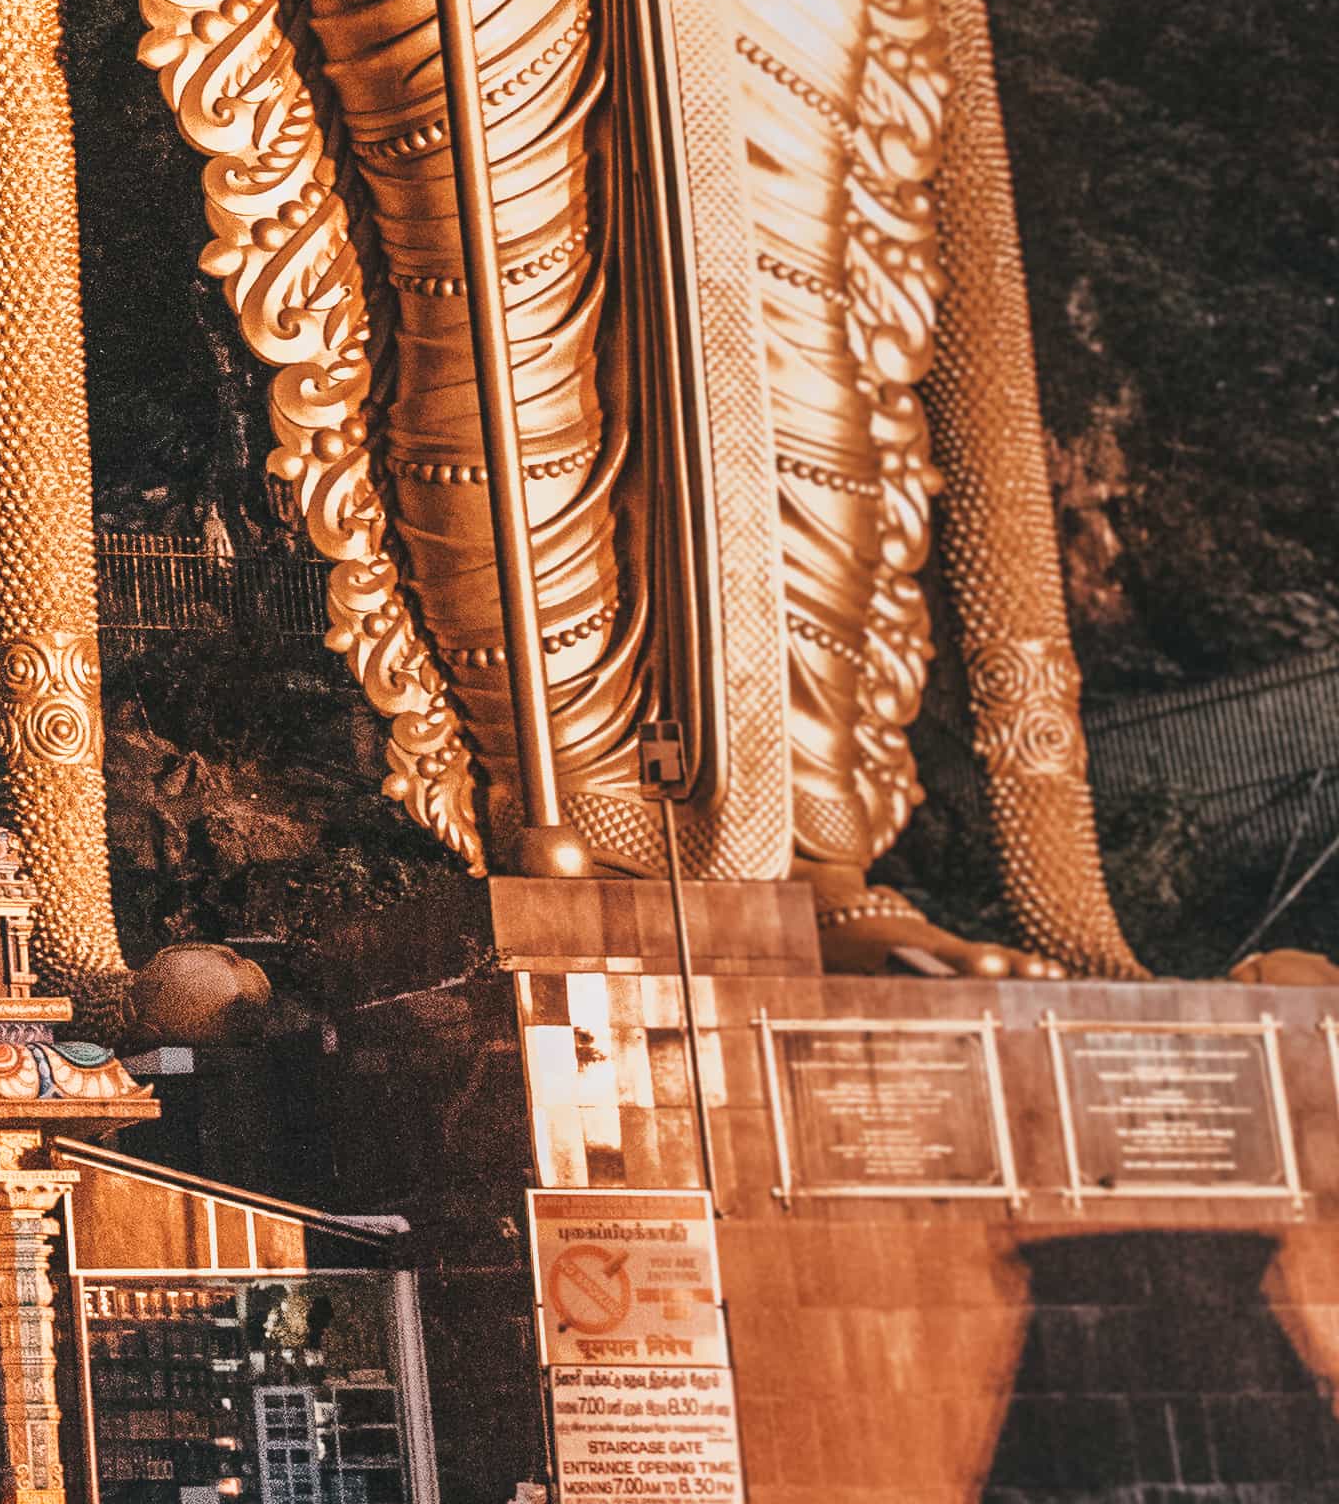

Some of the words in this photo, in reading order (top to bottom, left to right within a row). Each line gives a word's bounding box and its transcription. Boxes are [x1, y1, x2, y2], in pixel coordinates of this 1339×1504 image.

[578, 1397, 605, 1415] 7.00
[668, 1398, 698, 1416] 8.30
[588, 1441, 666, 1454] STAIRCASE
[669, 1442, 704, 1454] GATE
[563, 1461, 634, 1474] ENTRANCE
[638, 1462, 696, 1474] OPENING
[563, 1481, 613, 1494] MORNING
[663, 1482, 677, 1493] TO
[716, 1482, 735, 1493] PM
